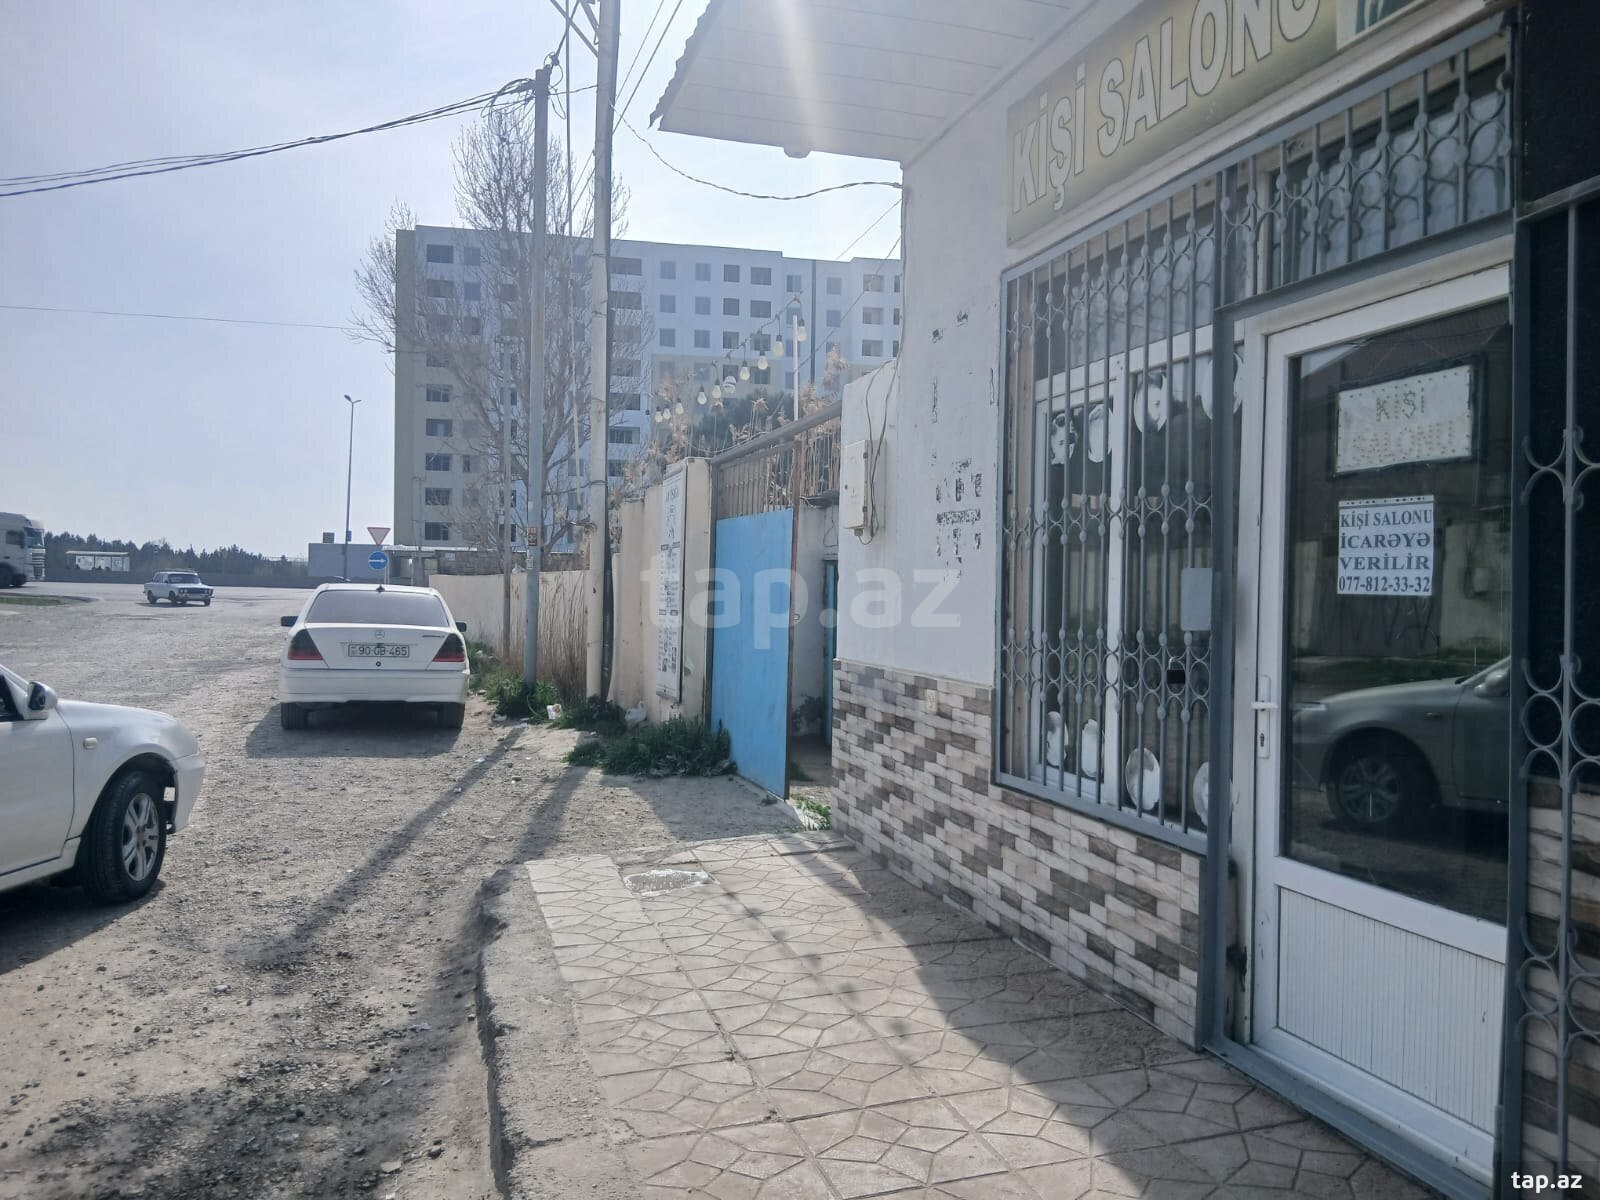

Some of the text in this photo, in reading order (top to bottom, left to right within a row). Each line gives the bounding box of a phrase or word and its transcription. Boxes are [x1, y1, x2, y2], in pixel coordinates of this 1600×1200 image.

[1012, 63, 1086, 215] KİŞİ
[1340, 508, 1433, 530] KİŞİ SALONU
[1340, 532, 1431, 549] İCARƏYƏ
[1340, 553, 1430, 571] VERİLİR
[1338, 576, 1430, 594] 077-812-33-32
